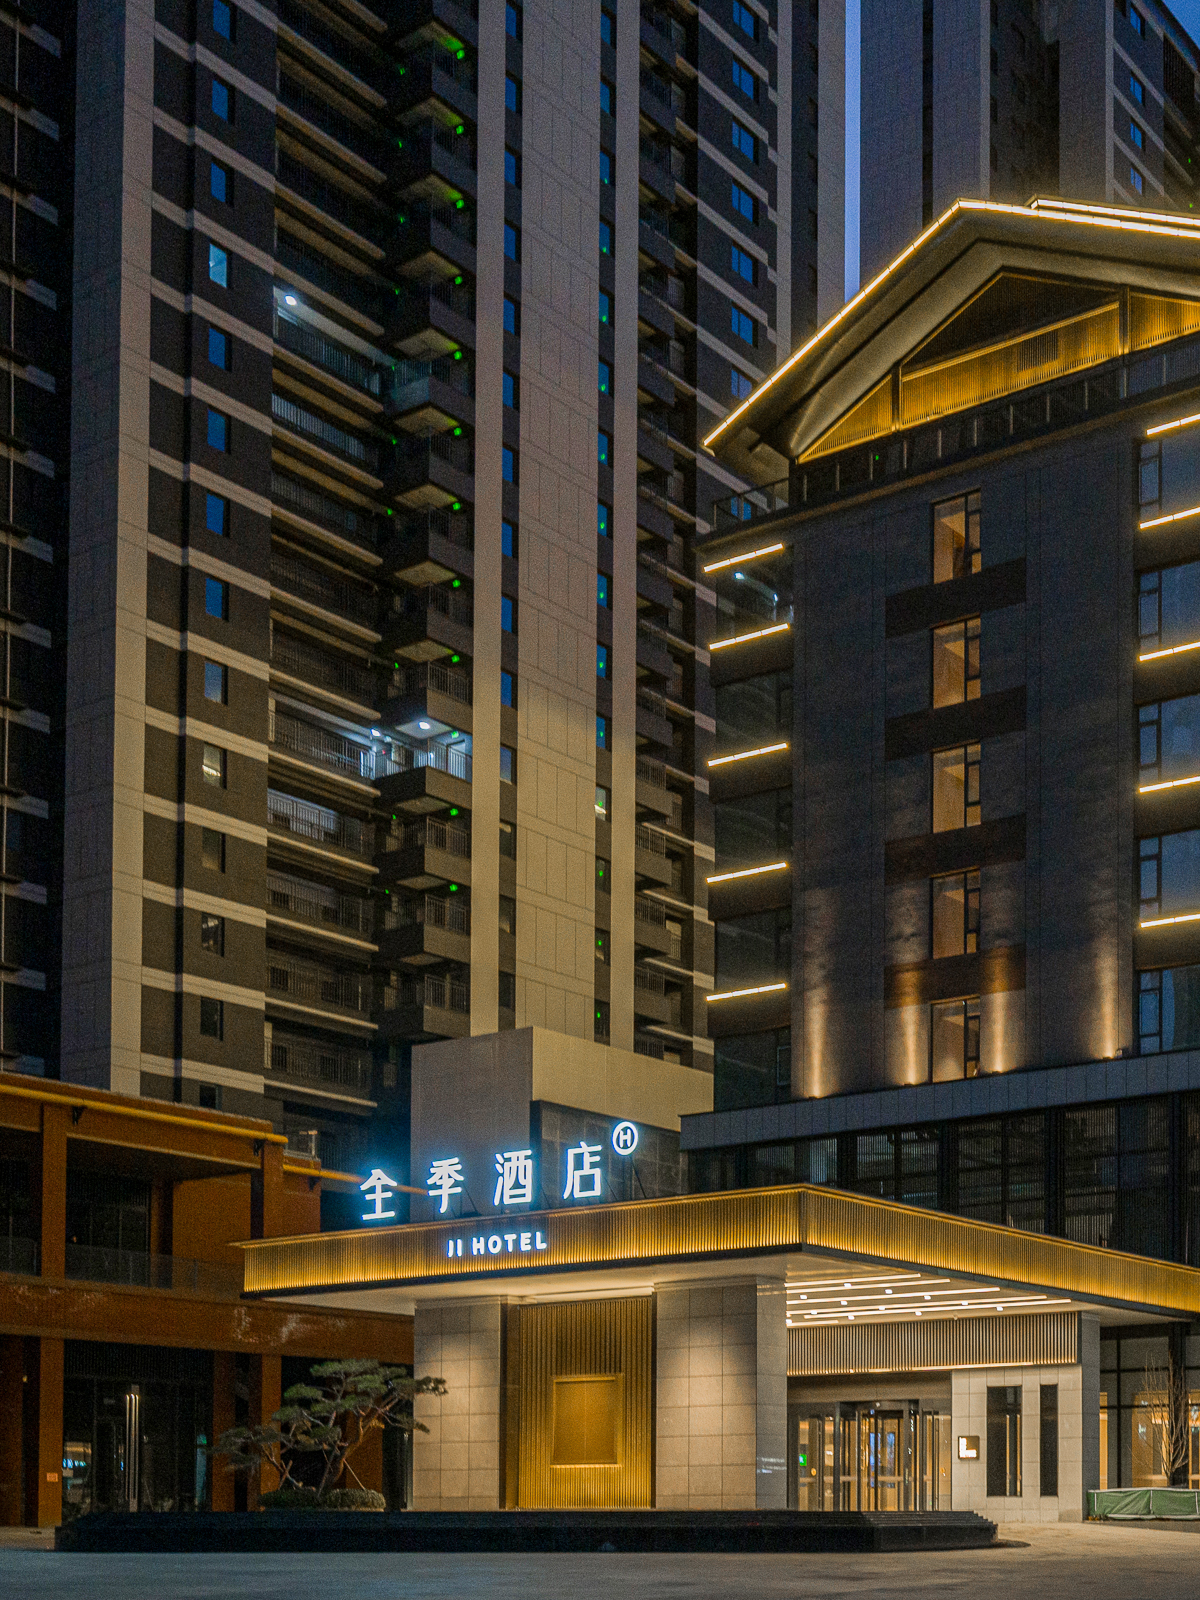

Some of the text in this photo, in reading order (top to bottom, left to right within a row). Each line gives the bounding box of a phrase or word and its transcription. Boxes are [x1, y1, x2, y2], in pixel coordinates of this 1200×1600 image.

[360, 1141, 602, 1221] 全季酒店
[447, 1231, 548, 1258] JI HOTEL
